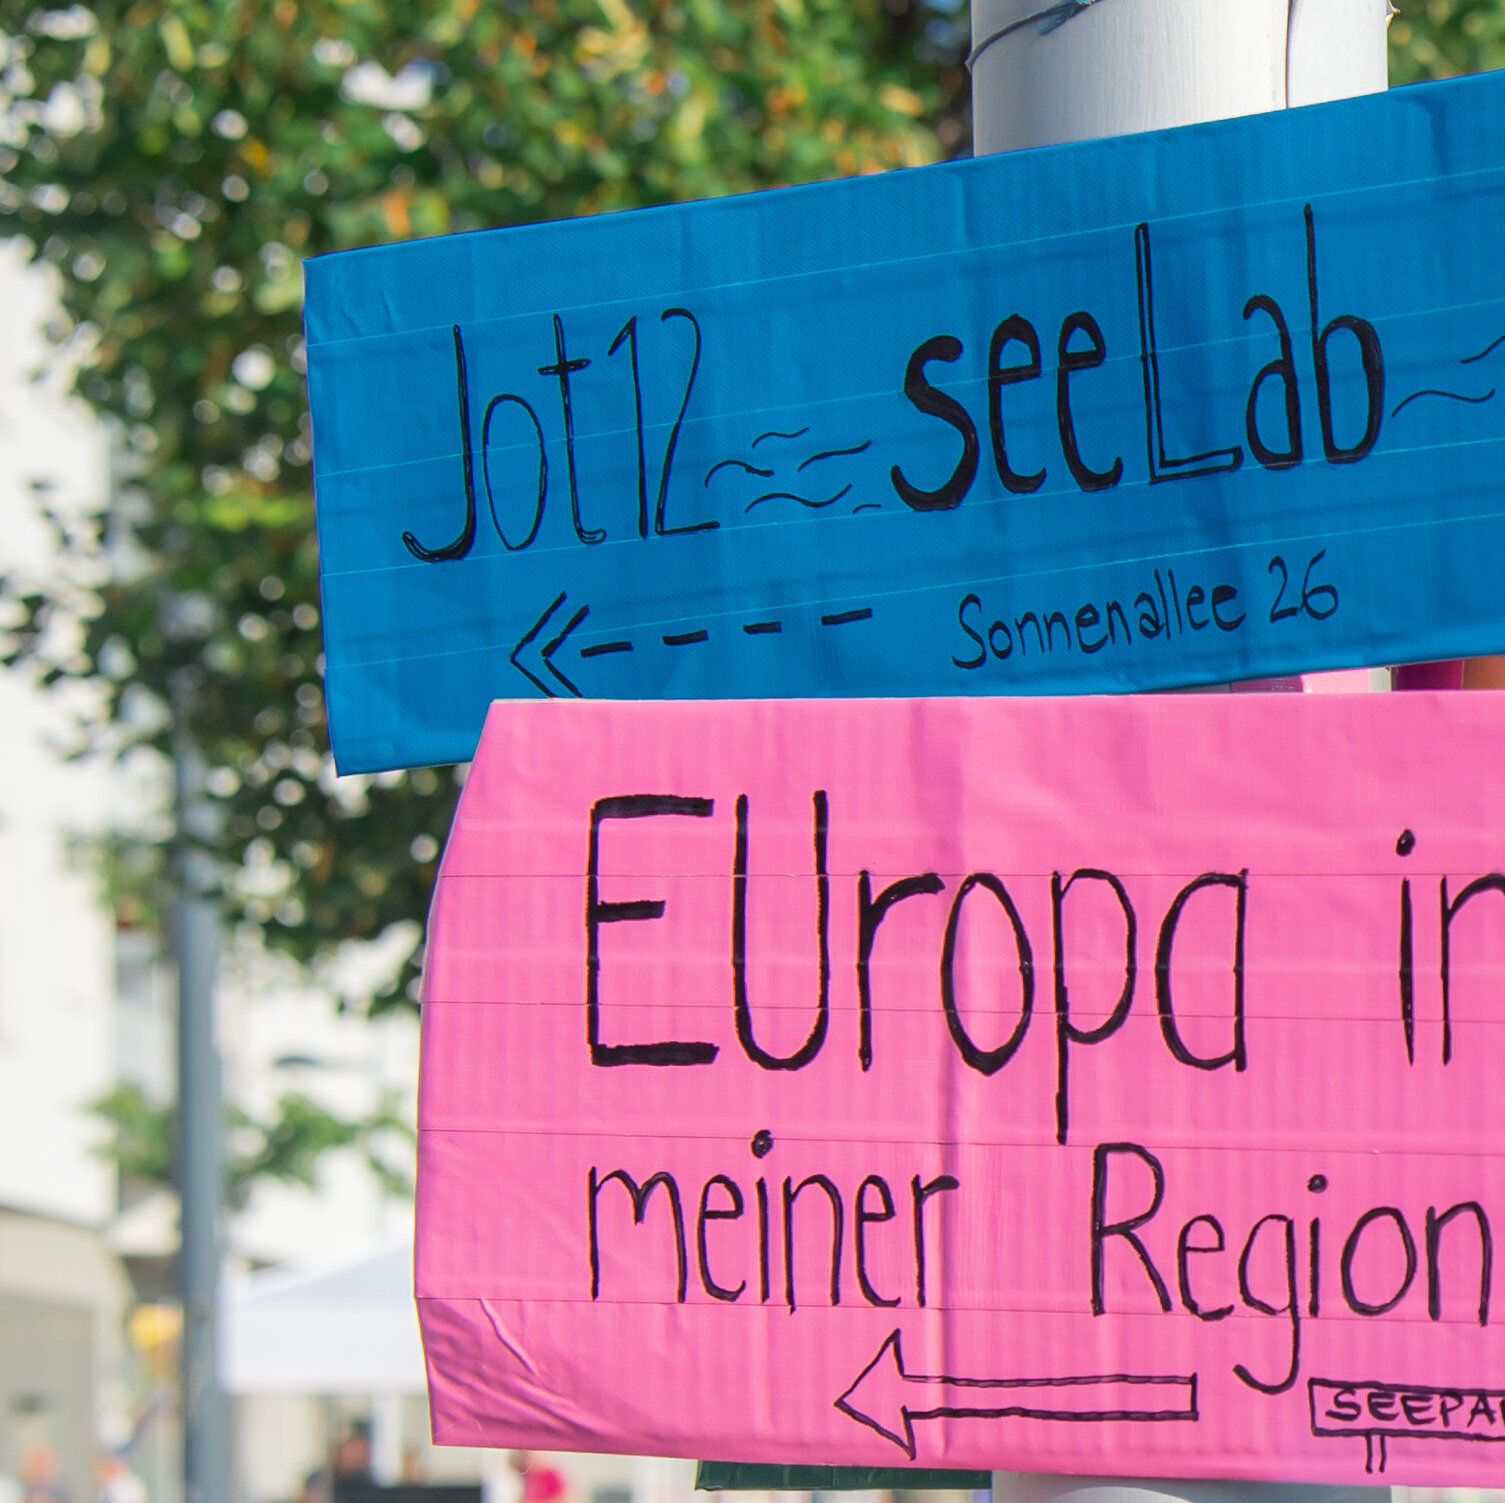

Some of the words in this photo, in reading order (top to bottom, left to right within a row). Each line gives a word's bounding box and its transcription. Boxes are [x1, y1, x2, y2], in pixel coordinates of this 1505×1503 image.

[402, 307, 720, 563] Jot12
[890, 202, 1385, 512] seeLab
[951, 567, 1247, 669] Sonnenallee
[1268, 549, 1339, 623] 26
[587, 790, 1247, 1146] EUropa
[588, 1129, 960, 1314] meiner
[1091, 1142, 1493, 1394] Region
